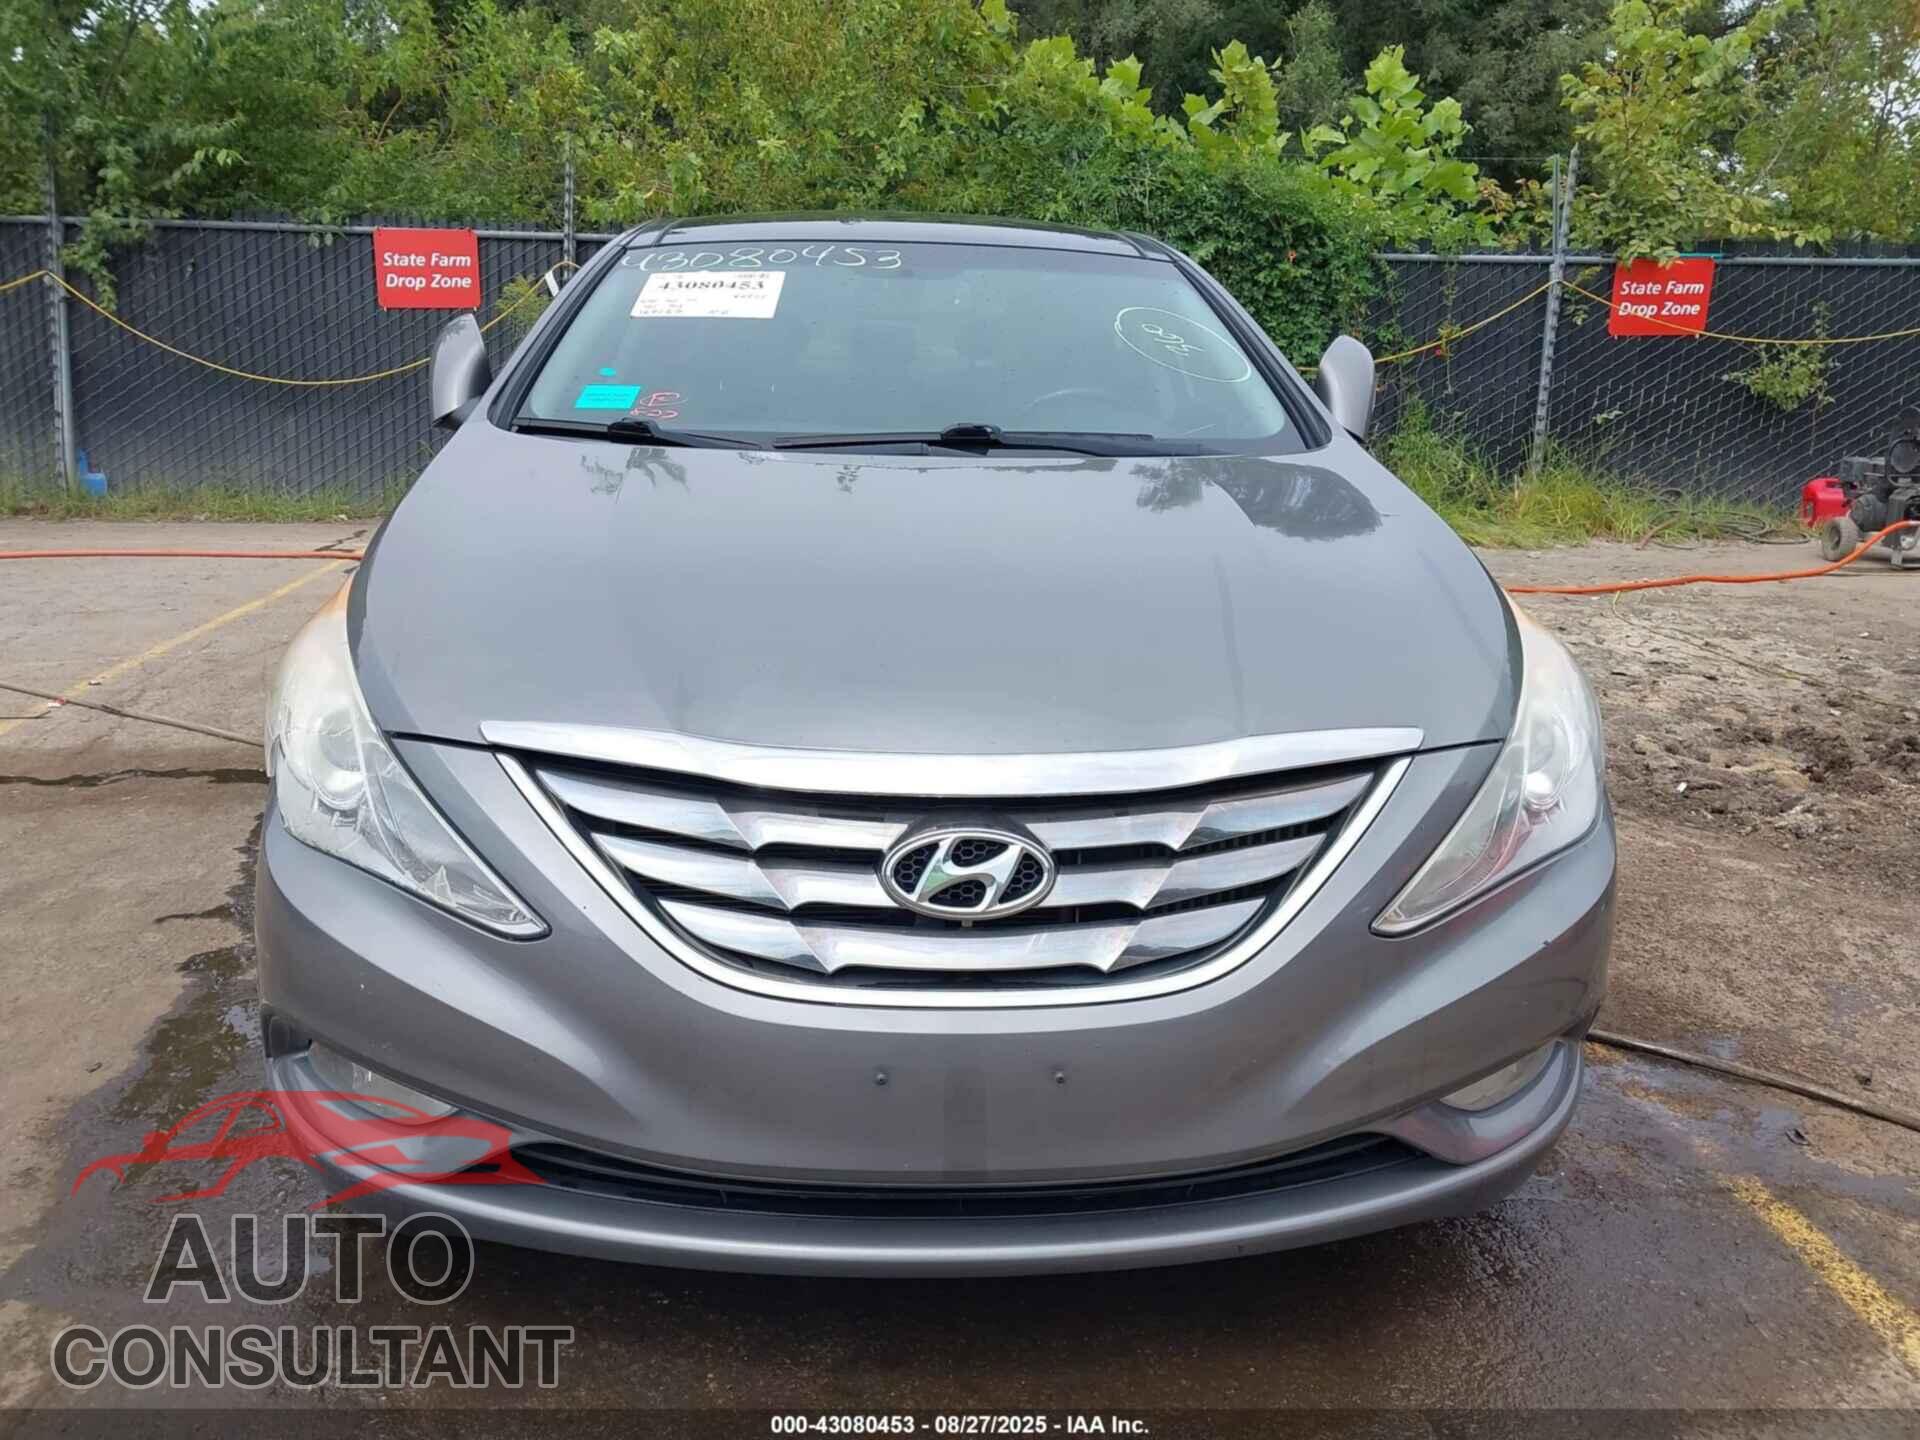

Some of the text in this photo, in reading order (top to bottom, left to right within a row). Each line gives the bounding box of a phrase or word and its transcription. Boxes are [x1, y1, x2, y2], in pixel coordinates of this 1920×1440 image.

[383, 252, 471, 267] State Farm
[622, 246, 902, 271] 43080453
[386, 273, 472, 291] Drop Zone
[1620, 281, 1704, 295] State Farm
[1618, 302, 1700, 318] Drop Zone
